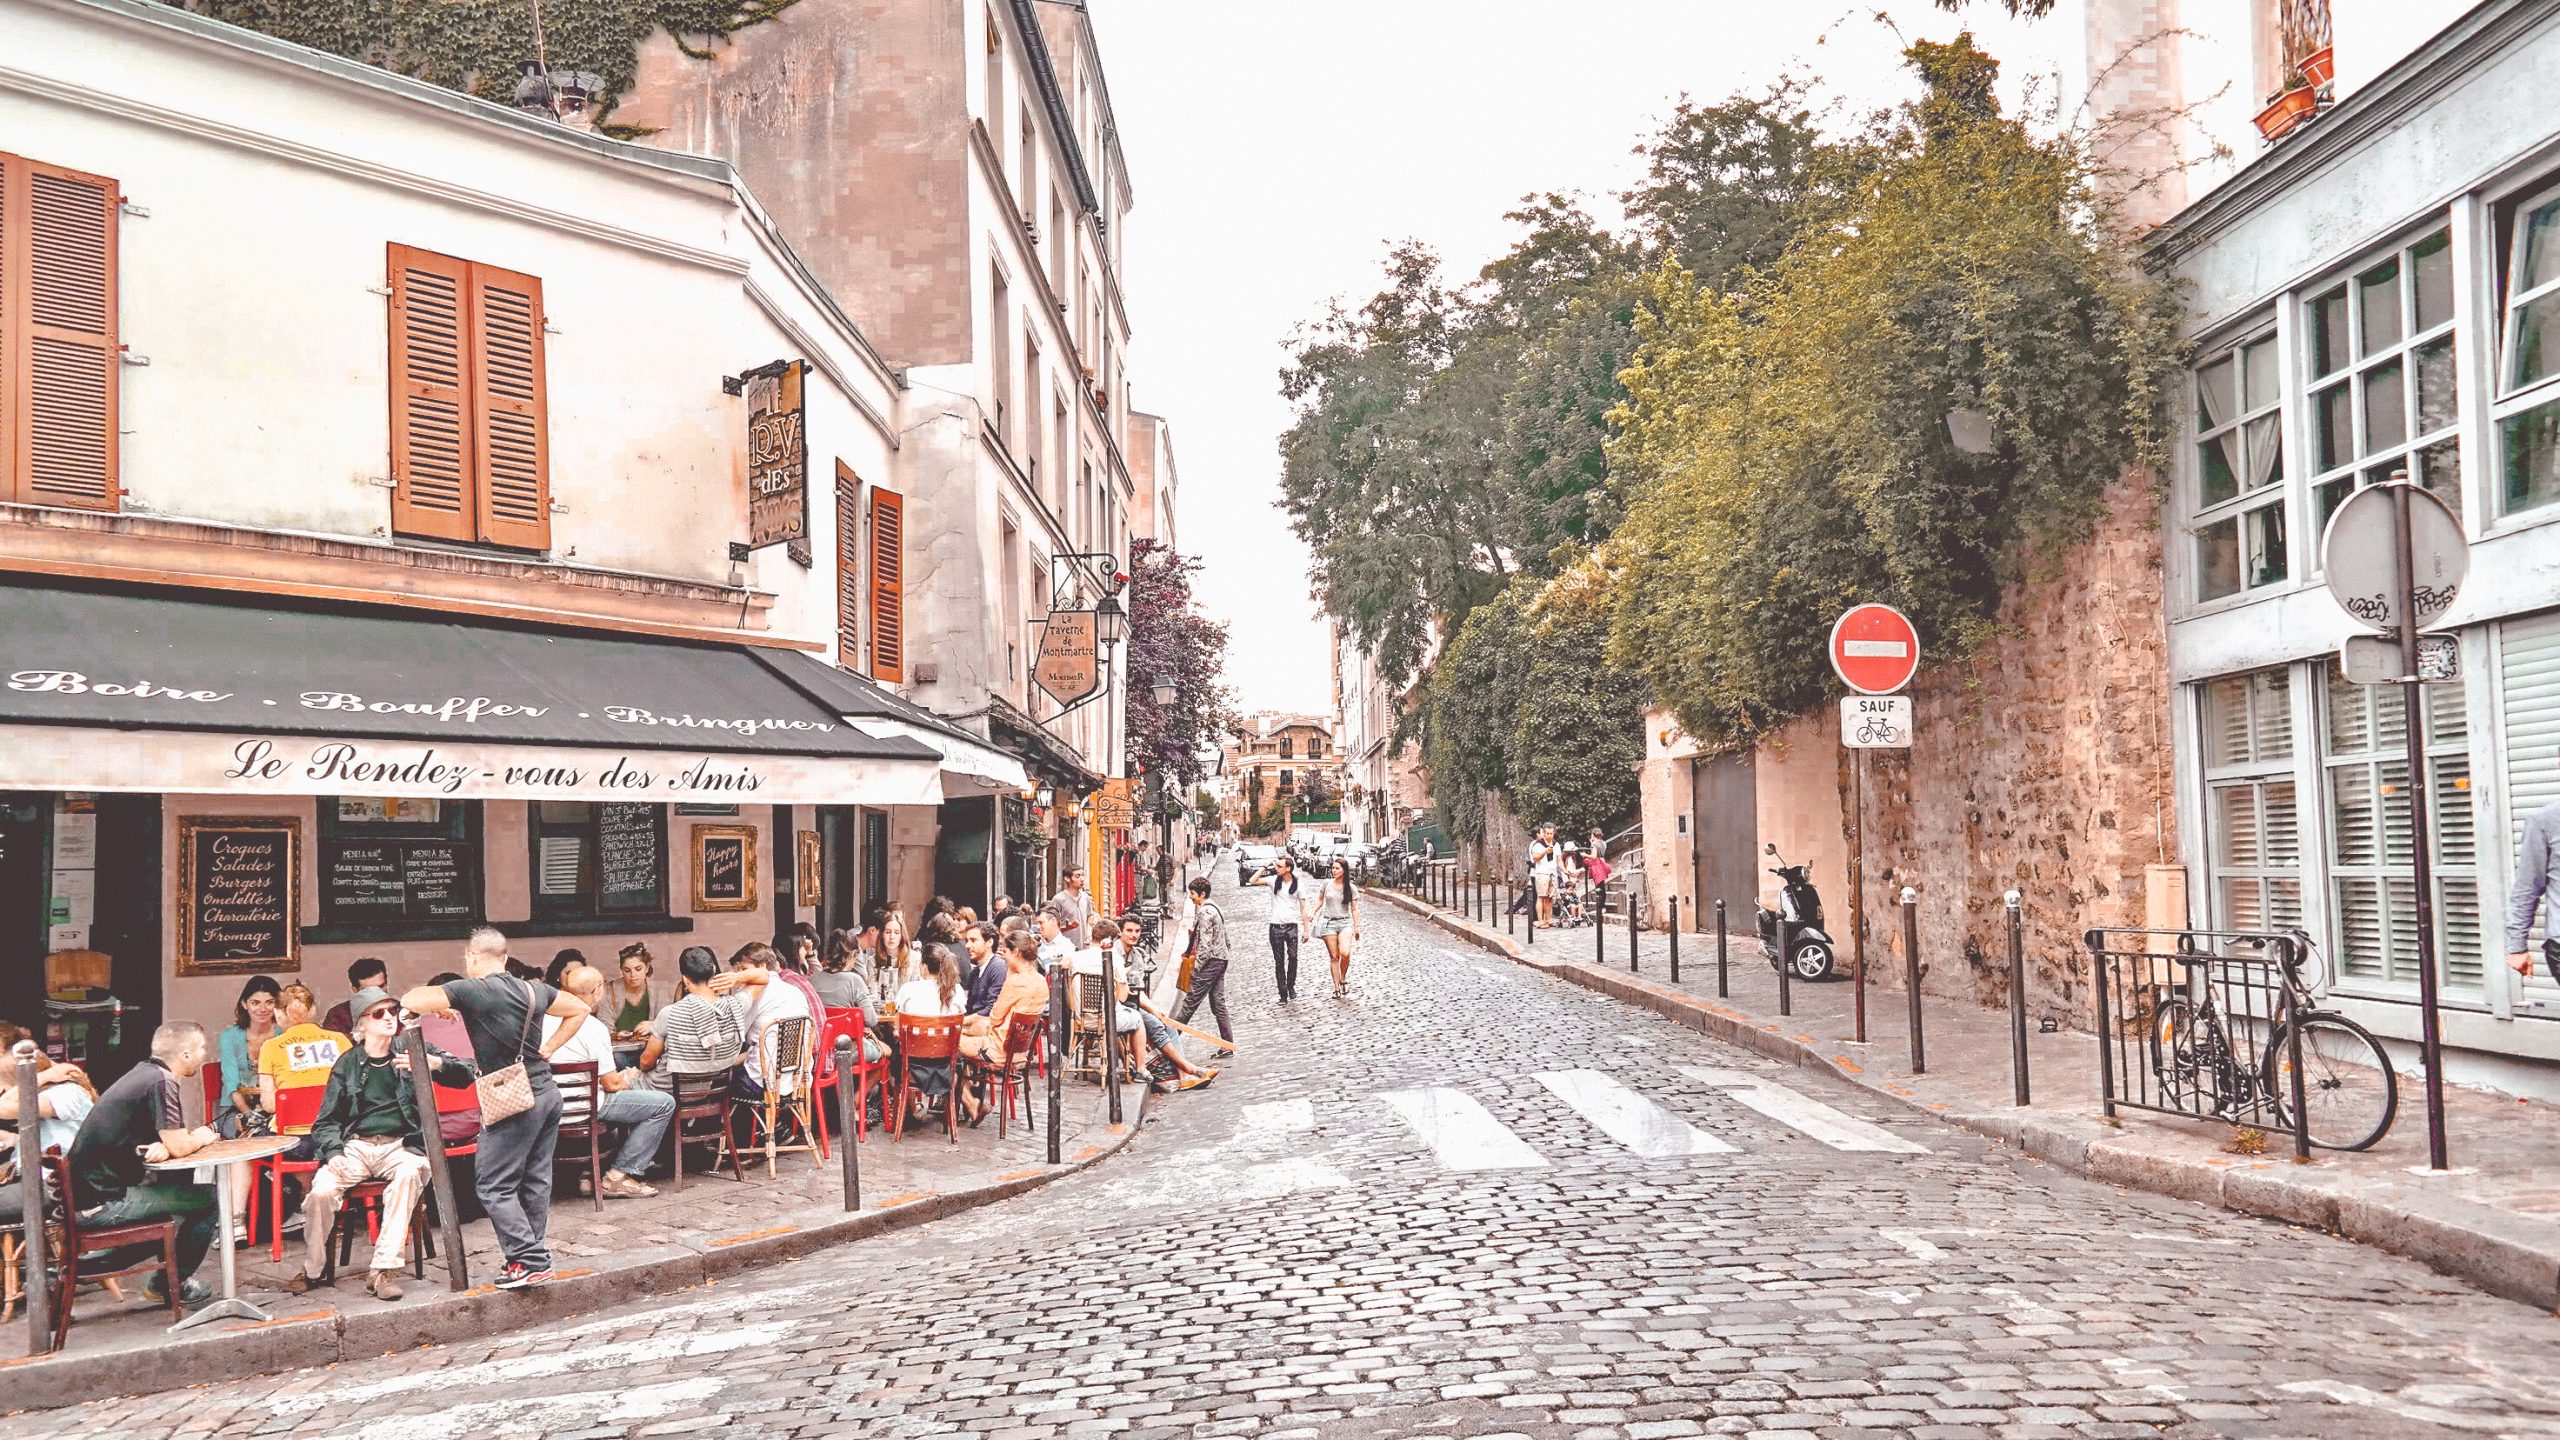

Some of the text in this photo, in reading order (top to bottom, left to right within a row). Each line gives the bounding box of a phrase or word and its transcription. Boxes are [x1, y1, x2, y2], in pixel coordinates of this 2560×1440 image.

[1061, 615, 1072, 624] La
[1050, 626, 1084, 636] Taverne
[1062, 636, 1072, 646] de
[1042, 647, 1094, 658] Montmartre
[7, 670, 835, 736] Boire Bouffer Bringuer
[1860, 700, 1895, 712] SAUF
[224, 739, 293, 779] Le
[599, 756, 660, 789] des
[668, 757, 767, 791] Amis
[212, 835, 272, 861] Croques
[707, 845, 738, 863] Happy
[212, 856, 276, 872] Salades
[713, 859, 738, 878] hours
[209, 876, 273, 894] Burgers
[203, 892, 277, 906] Omelettes
[203, 908, 281, 923] Charcuterie
[202, 927, 272, 948] Fromage
[309, 1042, 337, 1064] 14
